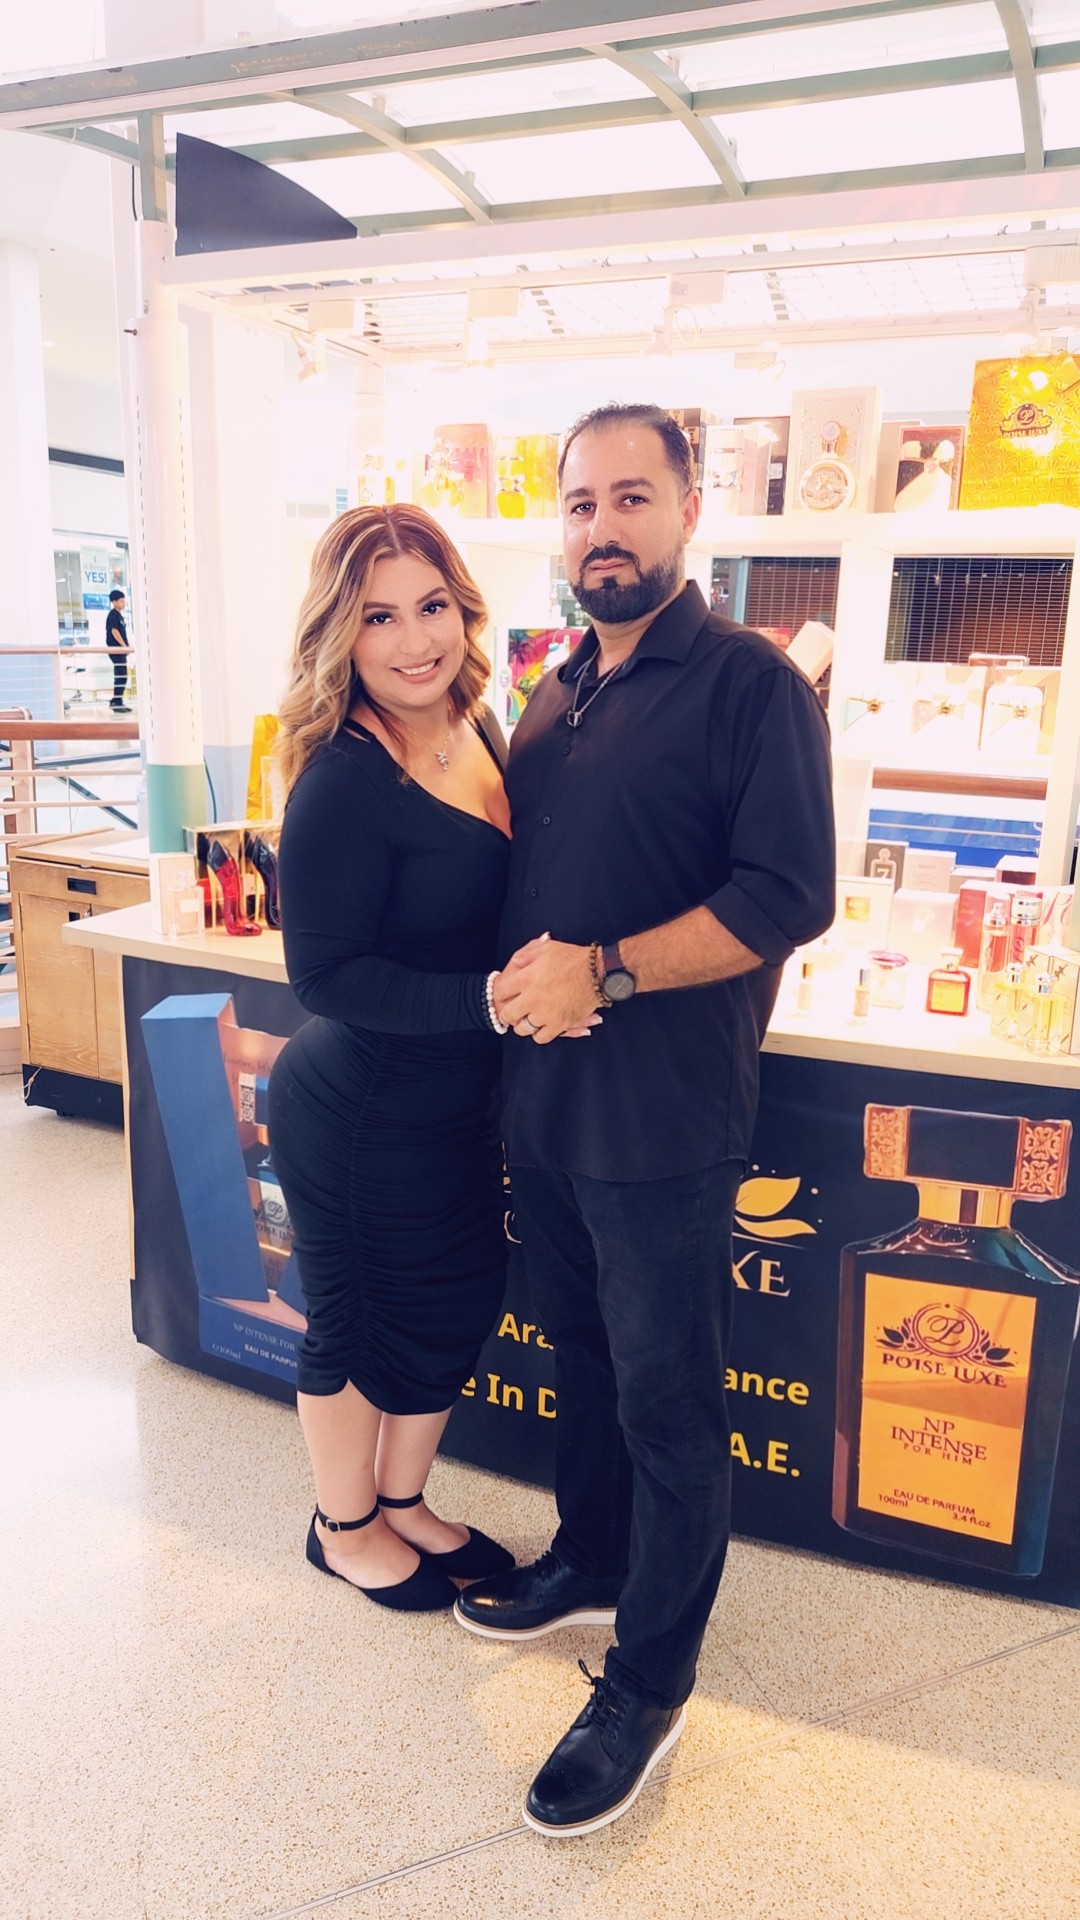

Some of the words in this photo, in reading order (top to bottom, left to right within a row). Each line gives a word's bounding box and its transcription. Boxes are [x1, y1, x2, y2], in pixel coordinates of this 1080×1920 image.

[84, 571, 108, 584] YES!
[731, 1250, 792, 1298] XE
[244, 1343, 259, 1355] EAU
[259, 1349, 270, 1359] DE
[245, 1326, 280, 1346] INTENSE
[279, 1338, 296, 1352] FOR
[498, 1312, 555, 1350] Ara
[724, 1367, 810, 1406] ance
[882, 1352, 947, 1376] POISE
[953, 1365, 1008, 1388] LUXE
[486, 1372, 524, 1412] In
[730, 1431, 801, 1478] A.E.
[923, 1416, 956, 1435] NP
[890, 1425, 988, 1461] INTENSE
[902, 1442, 932, 1456] FOR
[942, 1452, 973, 1466] HIM
[878, 1493, 908, 1508] 100ml
[893, 1488, 914, 1501] EAU
[916, 1494, 931, 1506] DE
[932, 1498, 976, 1516] PARFUM
